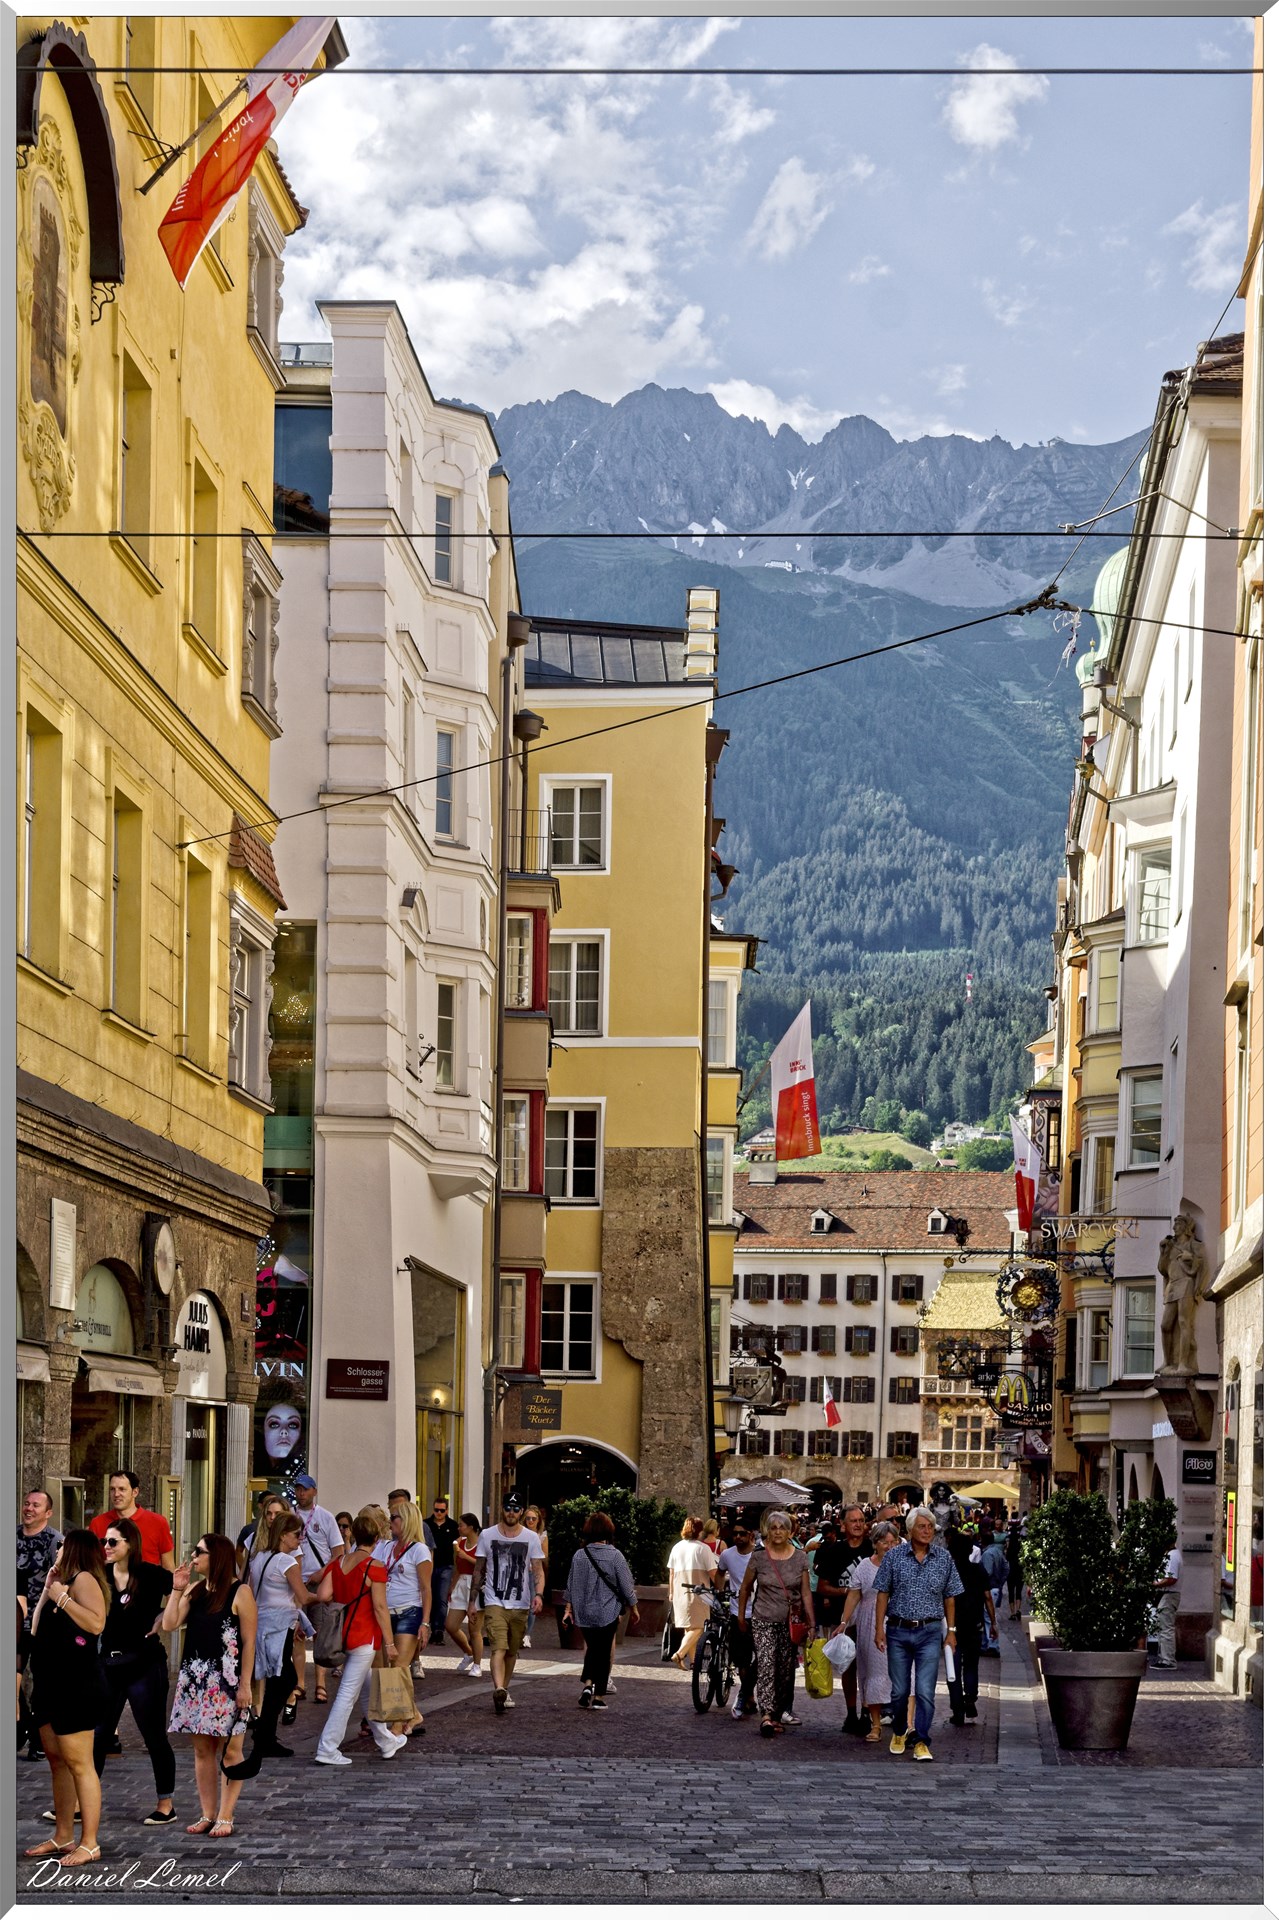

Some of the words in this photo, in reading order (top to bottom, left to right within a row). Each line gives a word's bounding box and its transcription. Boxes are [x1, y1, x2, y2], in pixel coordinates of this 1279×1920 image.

[801, 1091, 811, 1112] singt
[803, 1112, 815, 1152] Innsbruck
[1040, 1222, 1140, 1239] SWAROVSKI
[188, 1300, 209, 1325] JULIUS
[346, 1366, 386, 1377] Schlosser-
[361, 1378, 384, 1387] gasse
[532, 1395, 552, 1404] Der
[526, 1404, 558, 1414] Bäcker
[528, 1415, 555, 1424] Ruetz
[1185, 1457, 1214, 1470] Filou
